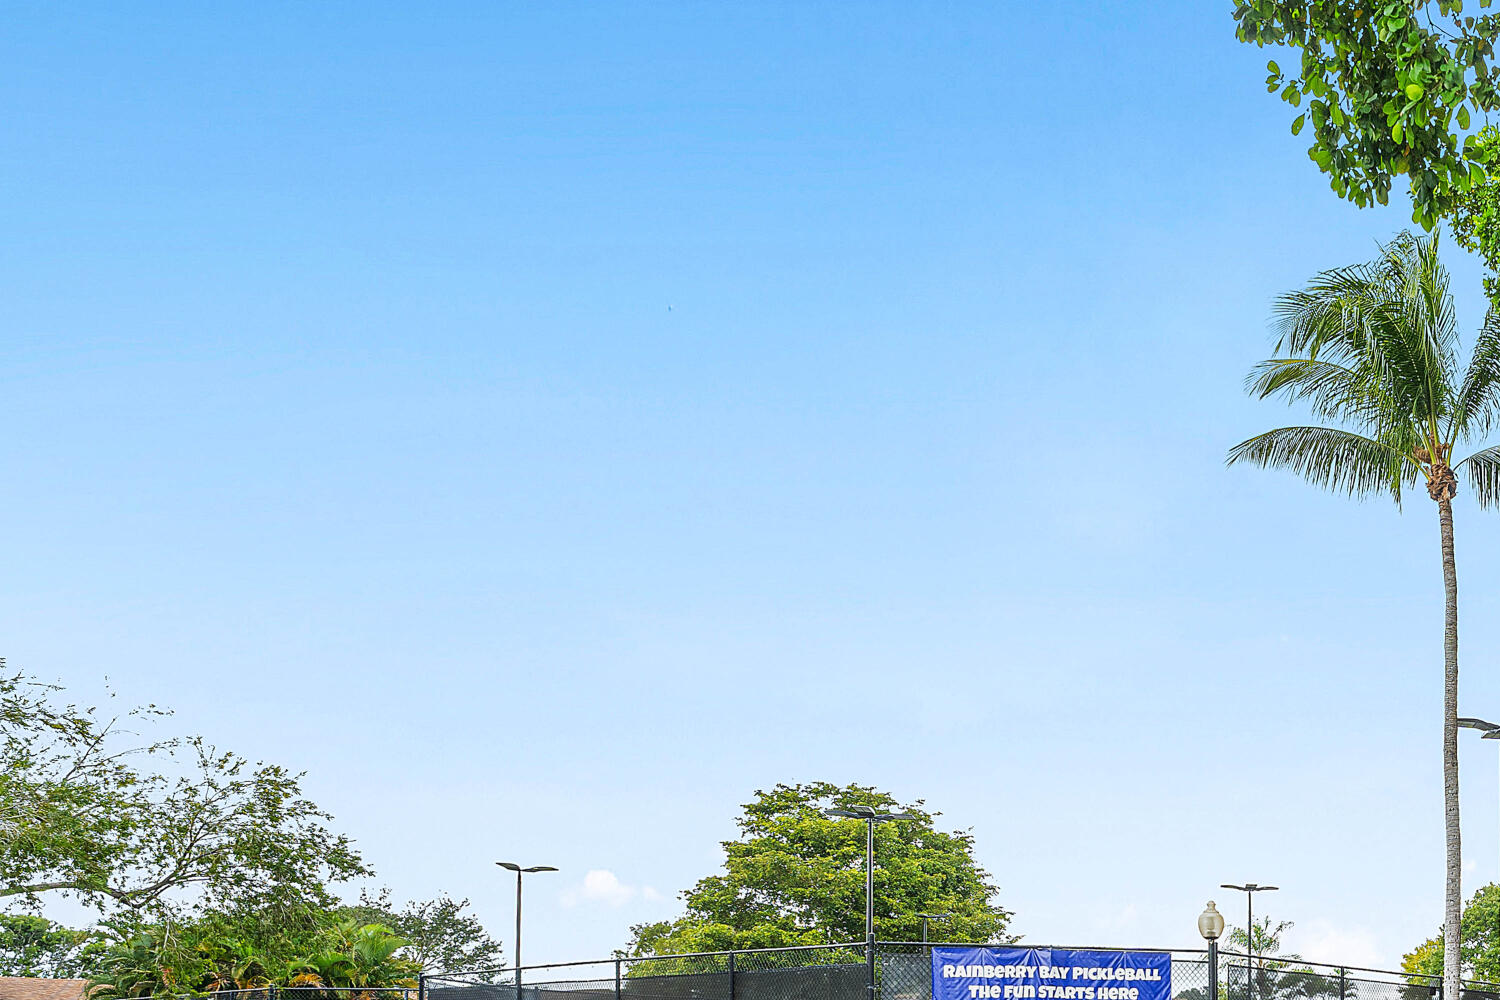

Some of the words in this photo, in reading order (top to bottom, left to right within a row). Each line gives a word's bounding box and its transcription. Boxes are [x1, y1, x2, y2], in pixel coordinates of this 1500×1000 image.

[943, 964, 1037, 979] RAINBERRY
[1038, 965, 1070, 979] BAY
[1072, 966, 1162, 981] PICKLEBALL
[968, 984, 1001, 999] THE
[1003, 984, 1036, 998] FUN
[1038, 985, 1095, 1000] STARTS
[1097, 986, 1139, 1000] HERE
